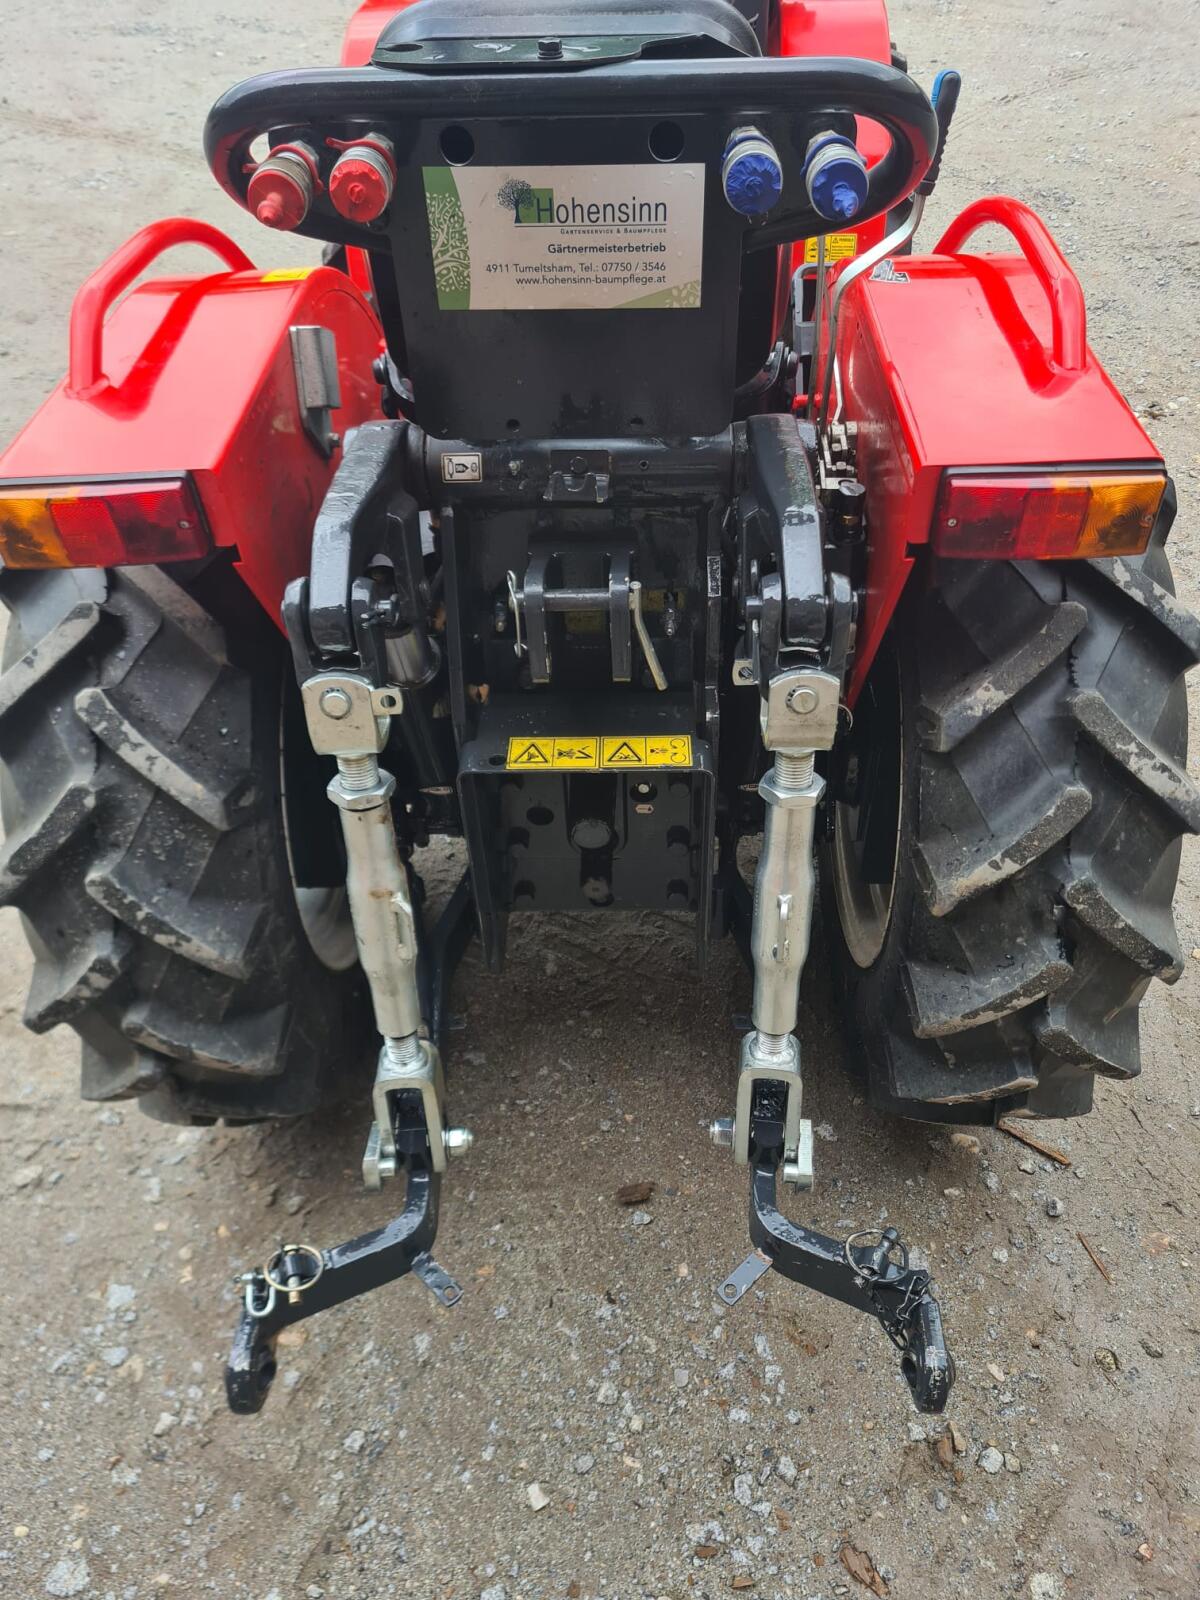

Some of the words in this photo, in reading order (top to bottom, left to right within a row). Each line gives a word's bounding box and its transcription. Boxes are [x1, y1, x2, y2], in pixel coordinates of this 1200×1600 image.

[536, 196, 666, 224] Hohensinn
[547, 242, 666, 254] Gärtnermeisterbetrieb
[486, 264, 510, 273] 4911
[513, 263, 576, 274] Tumeltsham,
[579, 263, 599, 273] Tel.:
[601, 262, 632, 272] 07750
[634, 262, 640, 273] /
[641, 262, 666, 272] 3546
[515, 274, 666, 286] www.hohensinn-baumpflege.at
